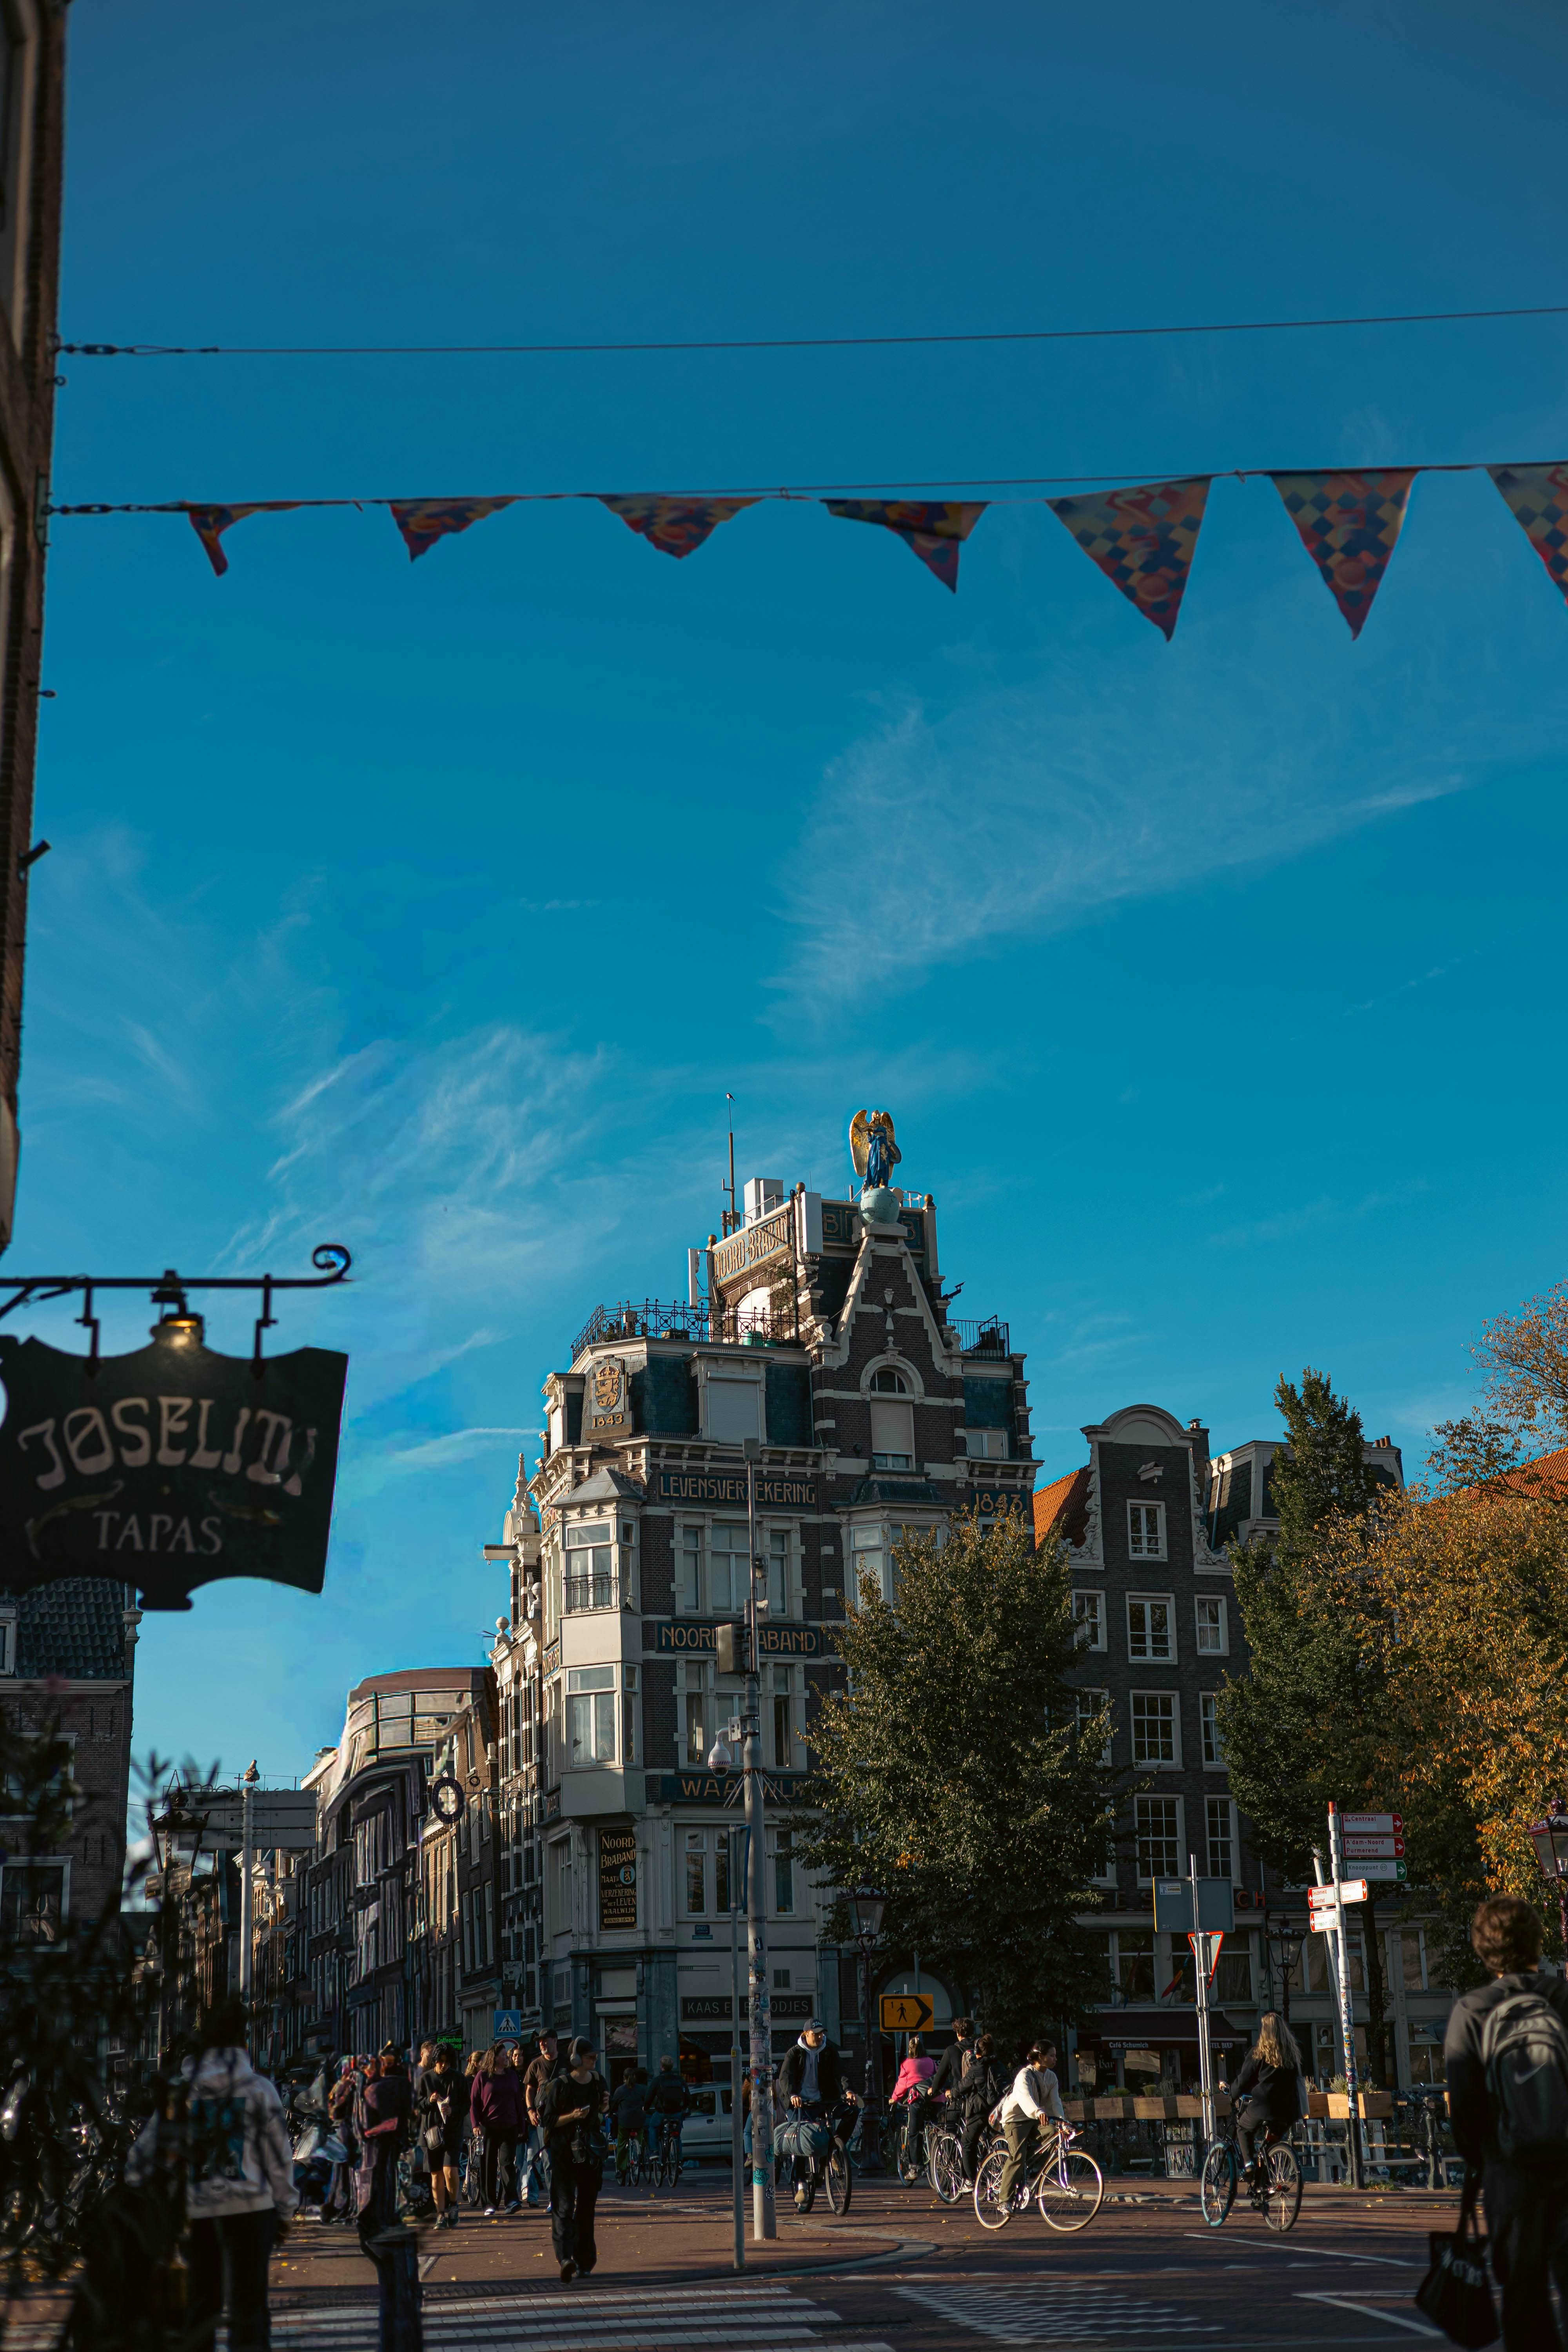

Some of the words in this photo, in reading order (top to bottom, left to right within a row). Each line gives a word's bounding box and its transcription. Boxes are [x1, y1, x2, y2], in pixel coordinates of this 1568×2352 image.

[593, 1414, 622, 1427] 1843
[976, 1493, 1023, 1514] 1843
[92, 1511, 223, 1555] TAPAS
[602, 1836, 636, 1849] NOORD-
[601, 1850, 636, 1869] BRABAND
[601, 1888, 636, 1898] VERZEKERING
[616, 1897, 636, 1906] LEVEN
[688, 2002, 720, 2014] KAAS
[725, 2002, 731, 2013] E
